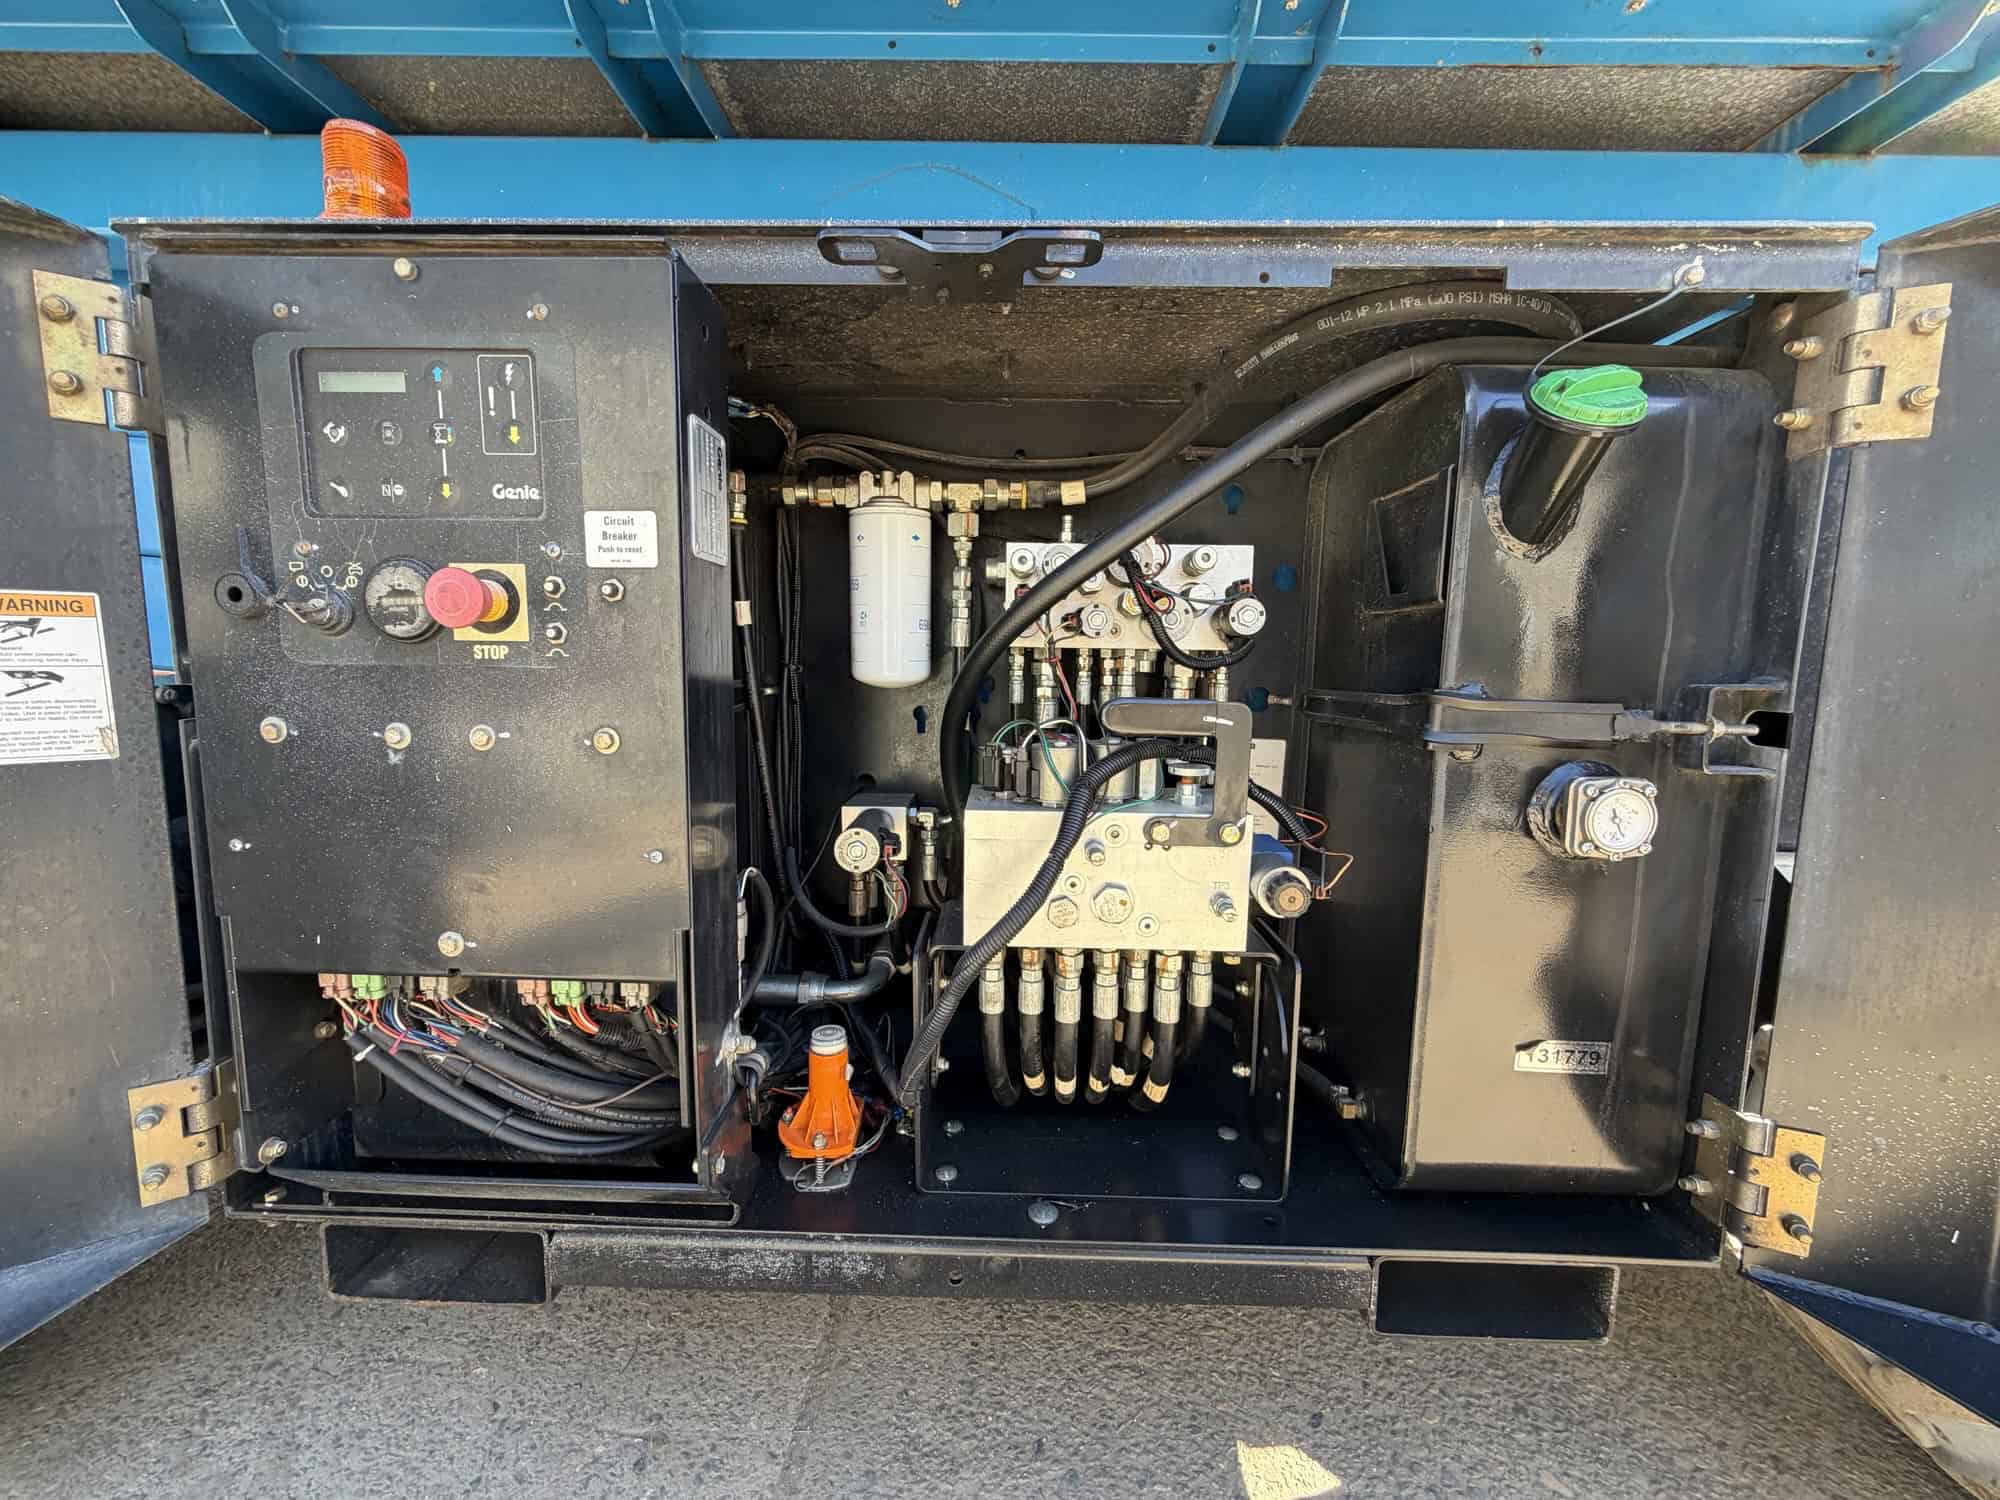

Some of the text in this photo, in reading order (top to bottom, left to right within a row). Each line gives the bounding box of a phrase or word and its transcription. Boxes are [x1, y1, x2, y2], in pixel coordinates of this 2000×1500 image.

[1375, 301, 1395, 314] 2.1
[1400, 296, 1421, 309] MPa
[1458, 291, 1484, 304] PSI)
[492, 483, 541, 500] Genie
[603, 515, 635, 527] Circuit
[601, 530, 638, 542] Breaker
[597, 544, 643, 554] Push to reset
[0, 597, 84, 613] ARNING
[473, 644, 509, 660] STOP
